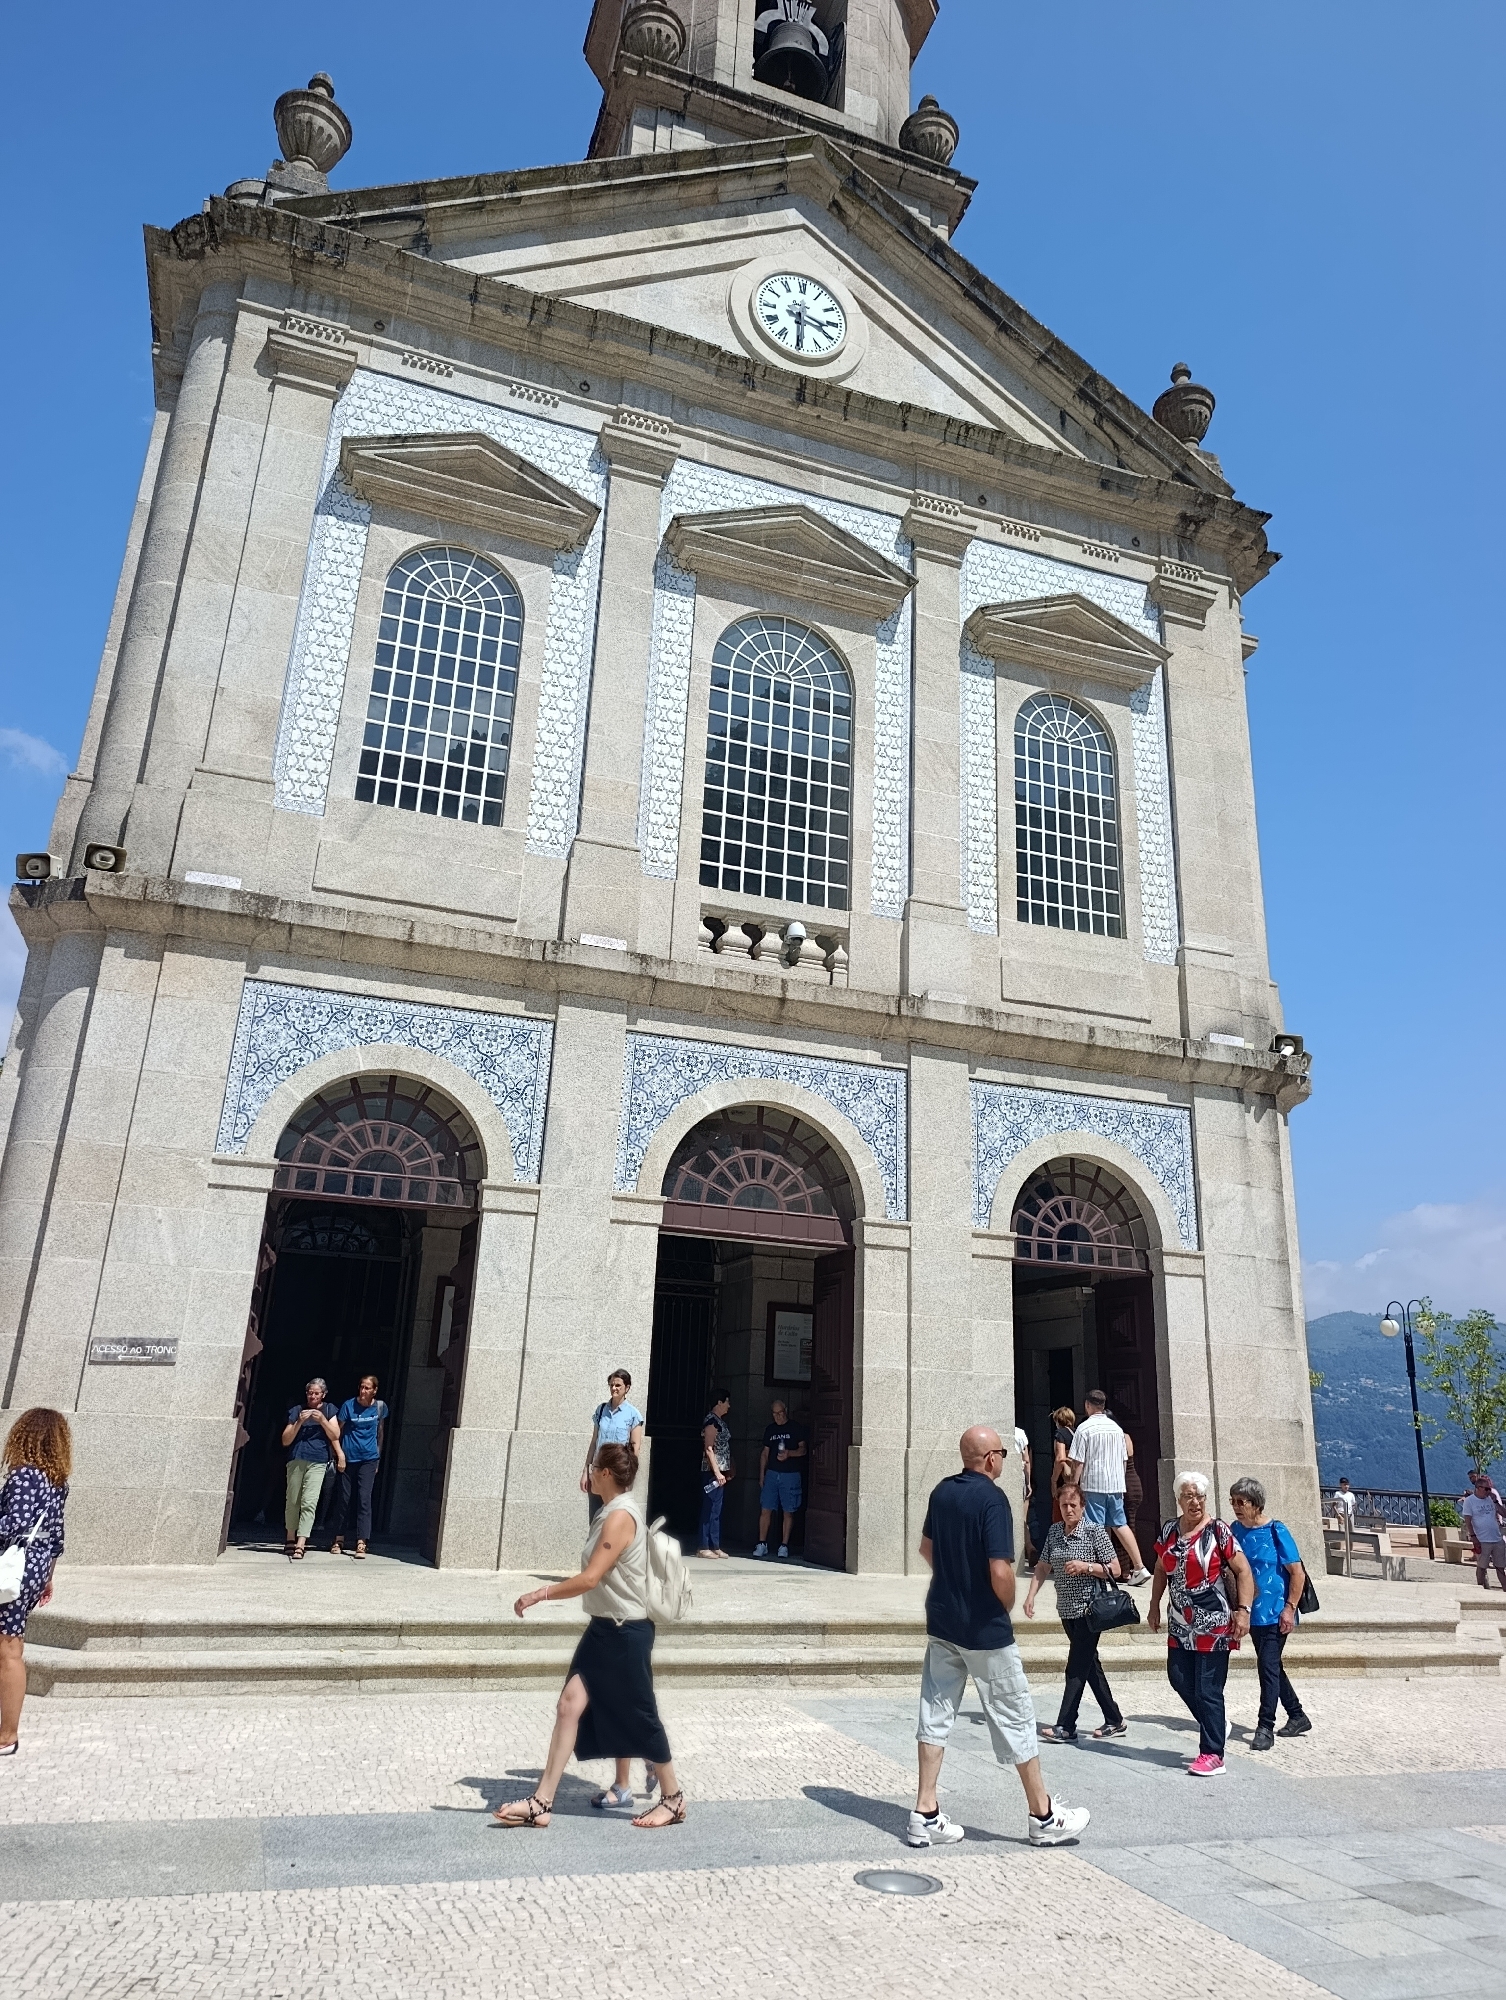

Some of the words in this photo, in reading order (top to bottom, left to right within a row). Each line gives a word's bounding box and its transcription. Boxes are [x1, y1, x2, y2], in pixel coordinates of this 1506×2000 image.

[91, 1344, 128, 1353] ACESSO
[129, 1346, 142, 1354] AO
[769, 1433, 791, 1441] JEANS
